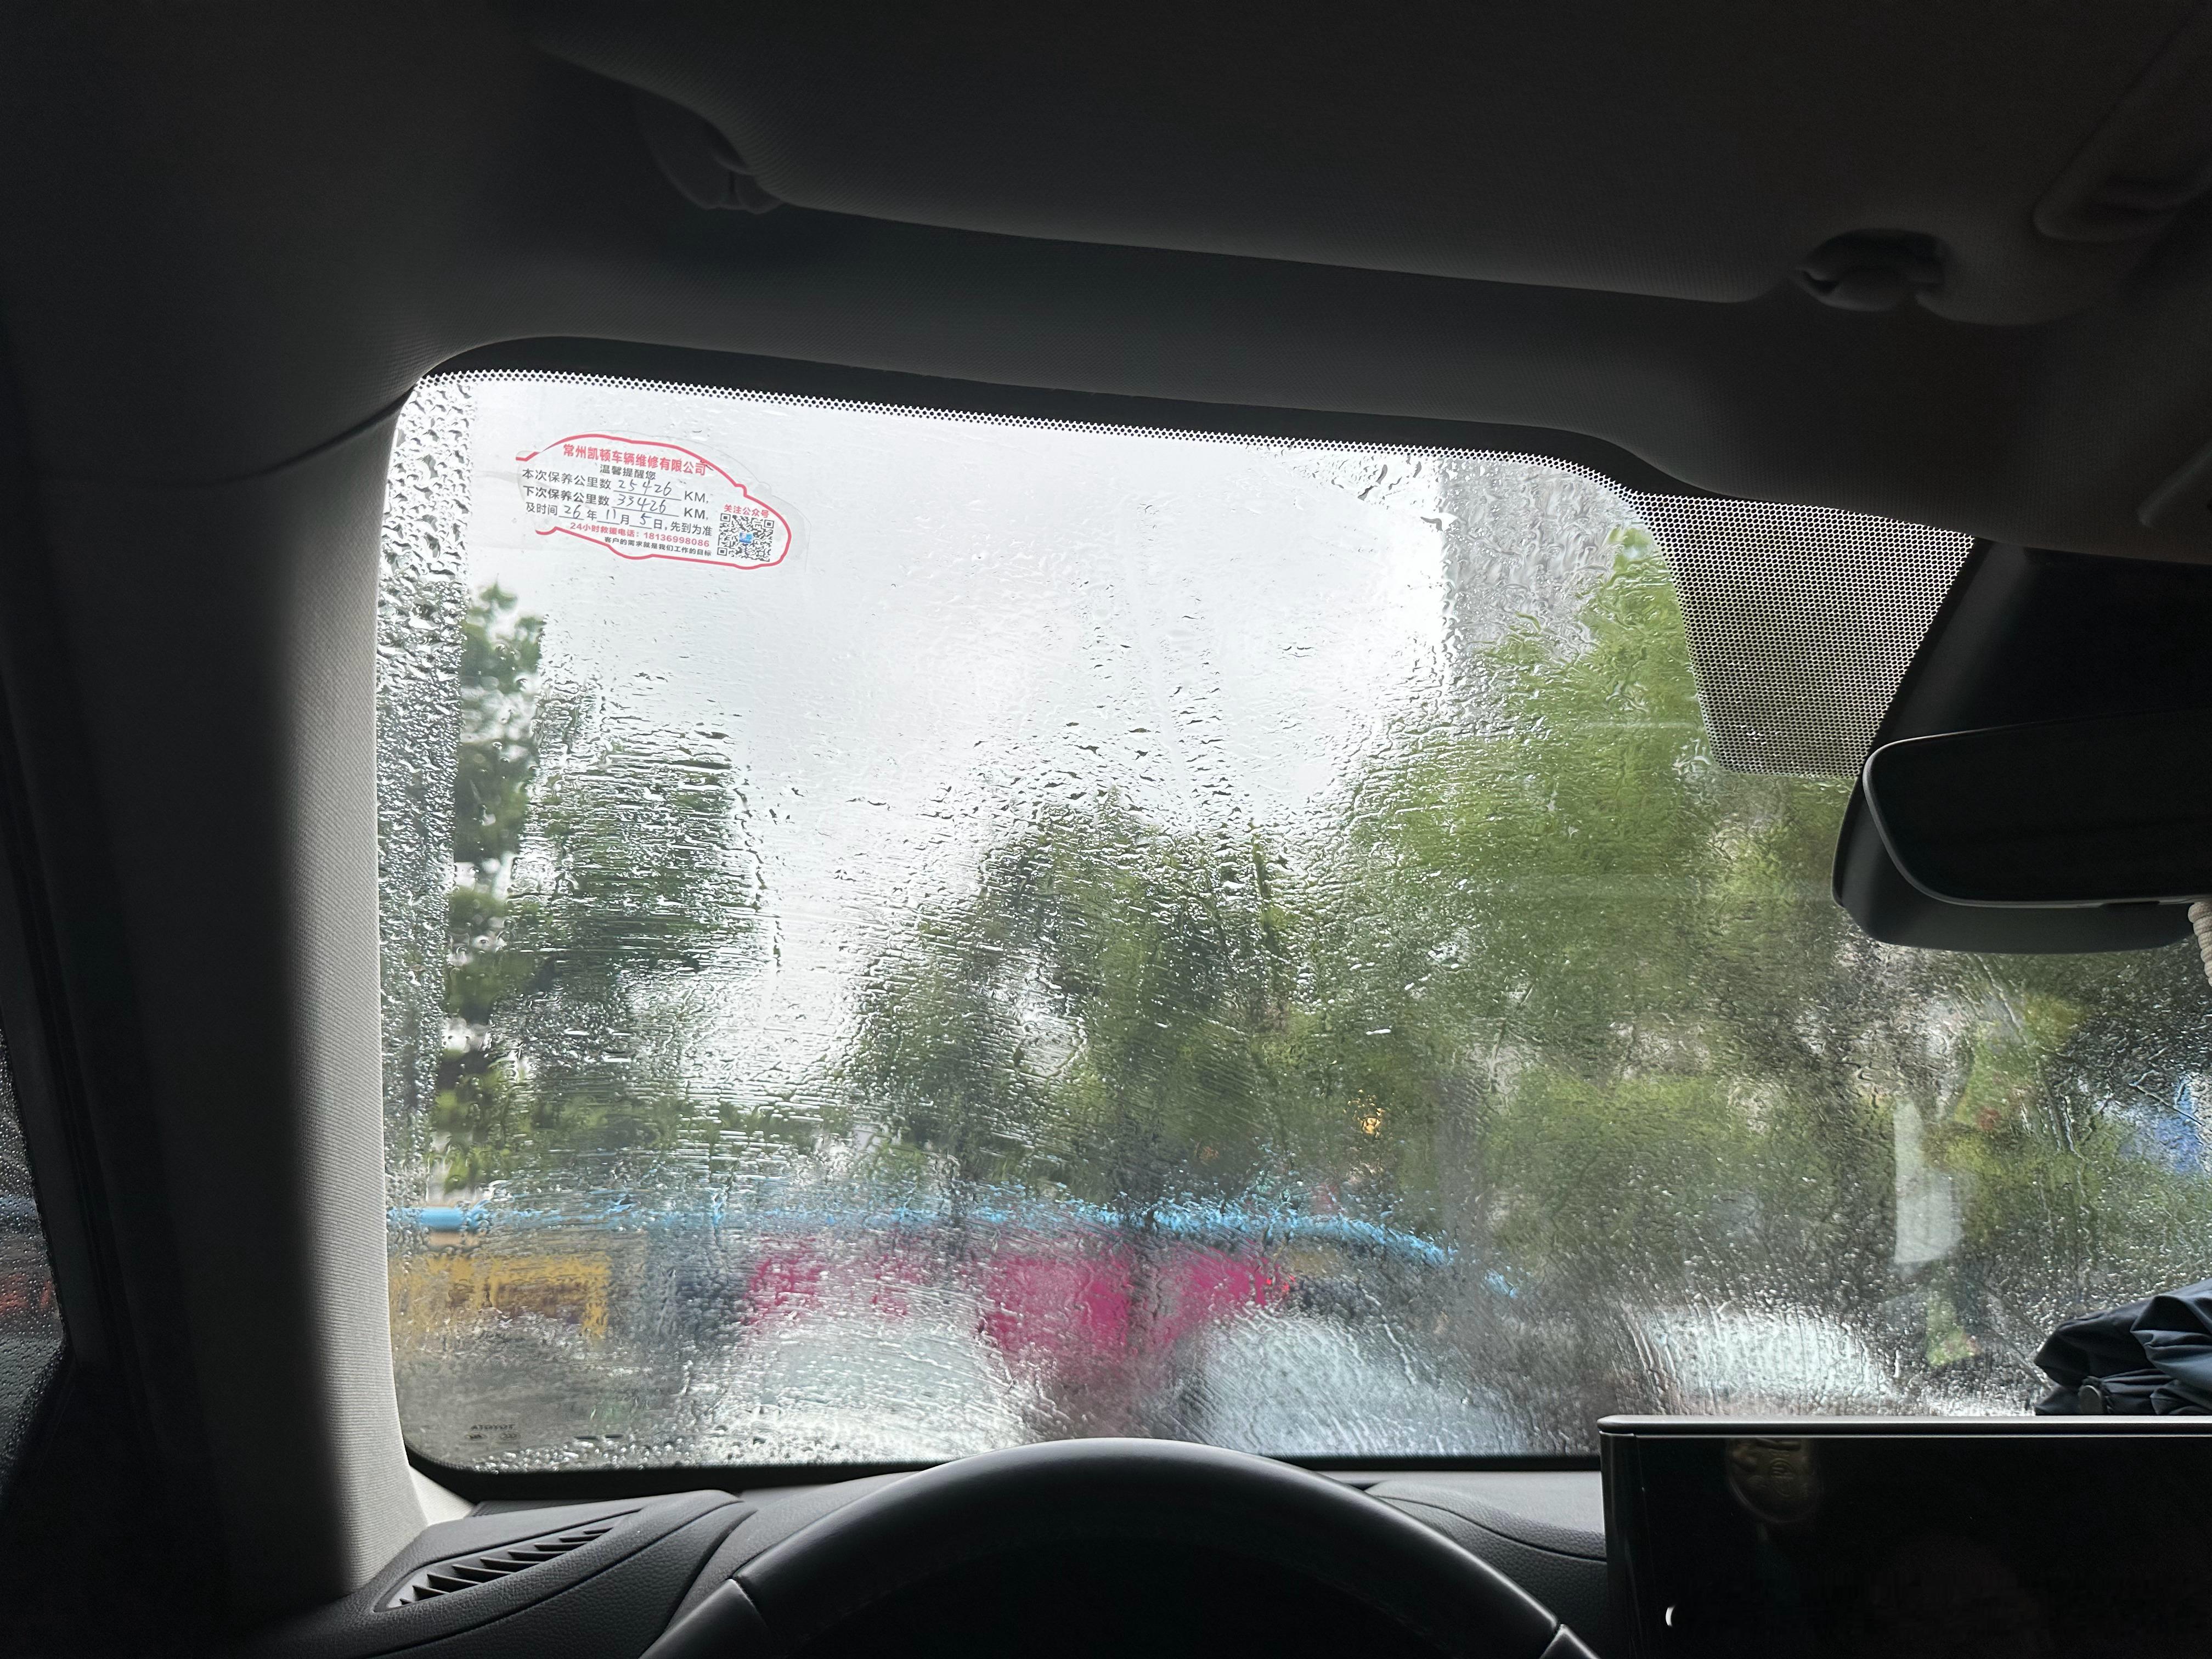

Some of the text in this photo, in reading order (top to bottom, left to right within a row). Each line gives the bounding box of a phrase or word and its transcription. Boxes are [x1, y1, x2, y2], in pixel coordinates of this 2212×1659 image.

[563, 443, 706, 476] 常州凯顿车辆维修有限公司
[522, 468, 612, 490] 本次保养公里数
[617, 478, 673, 496] 25426
[600, 464, 656, 480] 温馨提醒您
[522, 485, 610, 506] 下次保养公里数
[616, 494, 667, 514] 33426
[724, 504, 770, 518] 关注公众号
[526, 501, 558, 516] 及时间
[563, 504, 582, 519] 26
[586, 509, 597, 521] 年
[606, 509, 616, 520] 11
[620, 514, 630, 525] 月
[639, 513, 652, 525] 5
[604, 536, 712, 556] 客户的需求就是我们工作的目标
